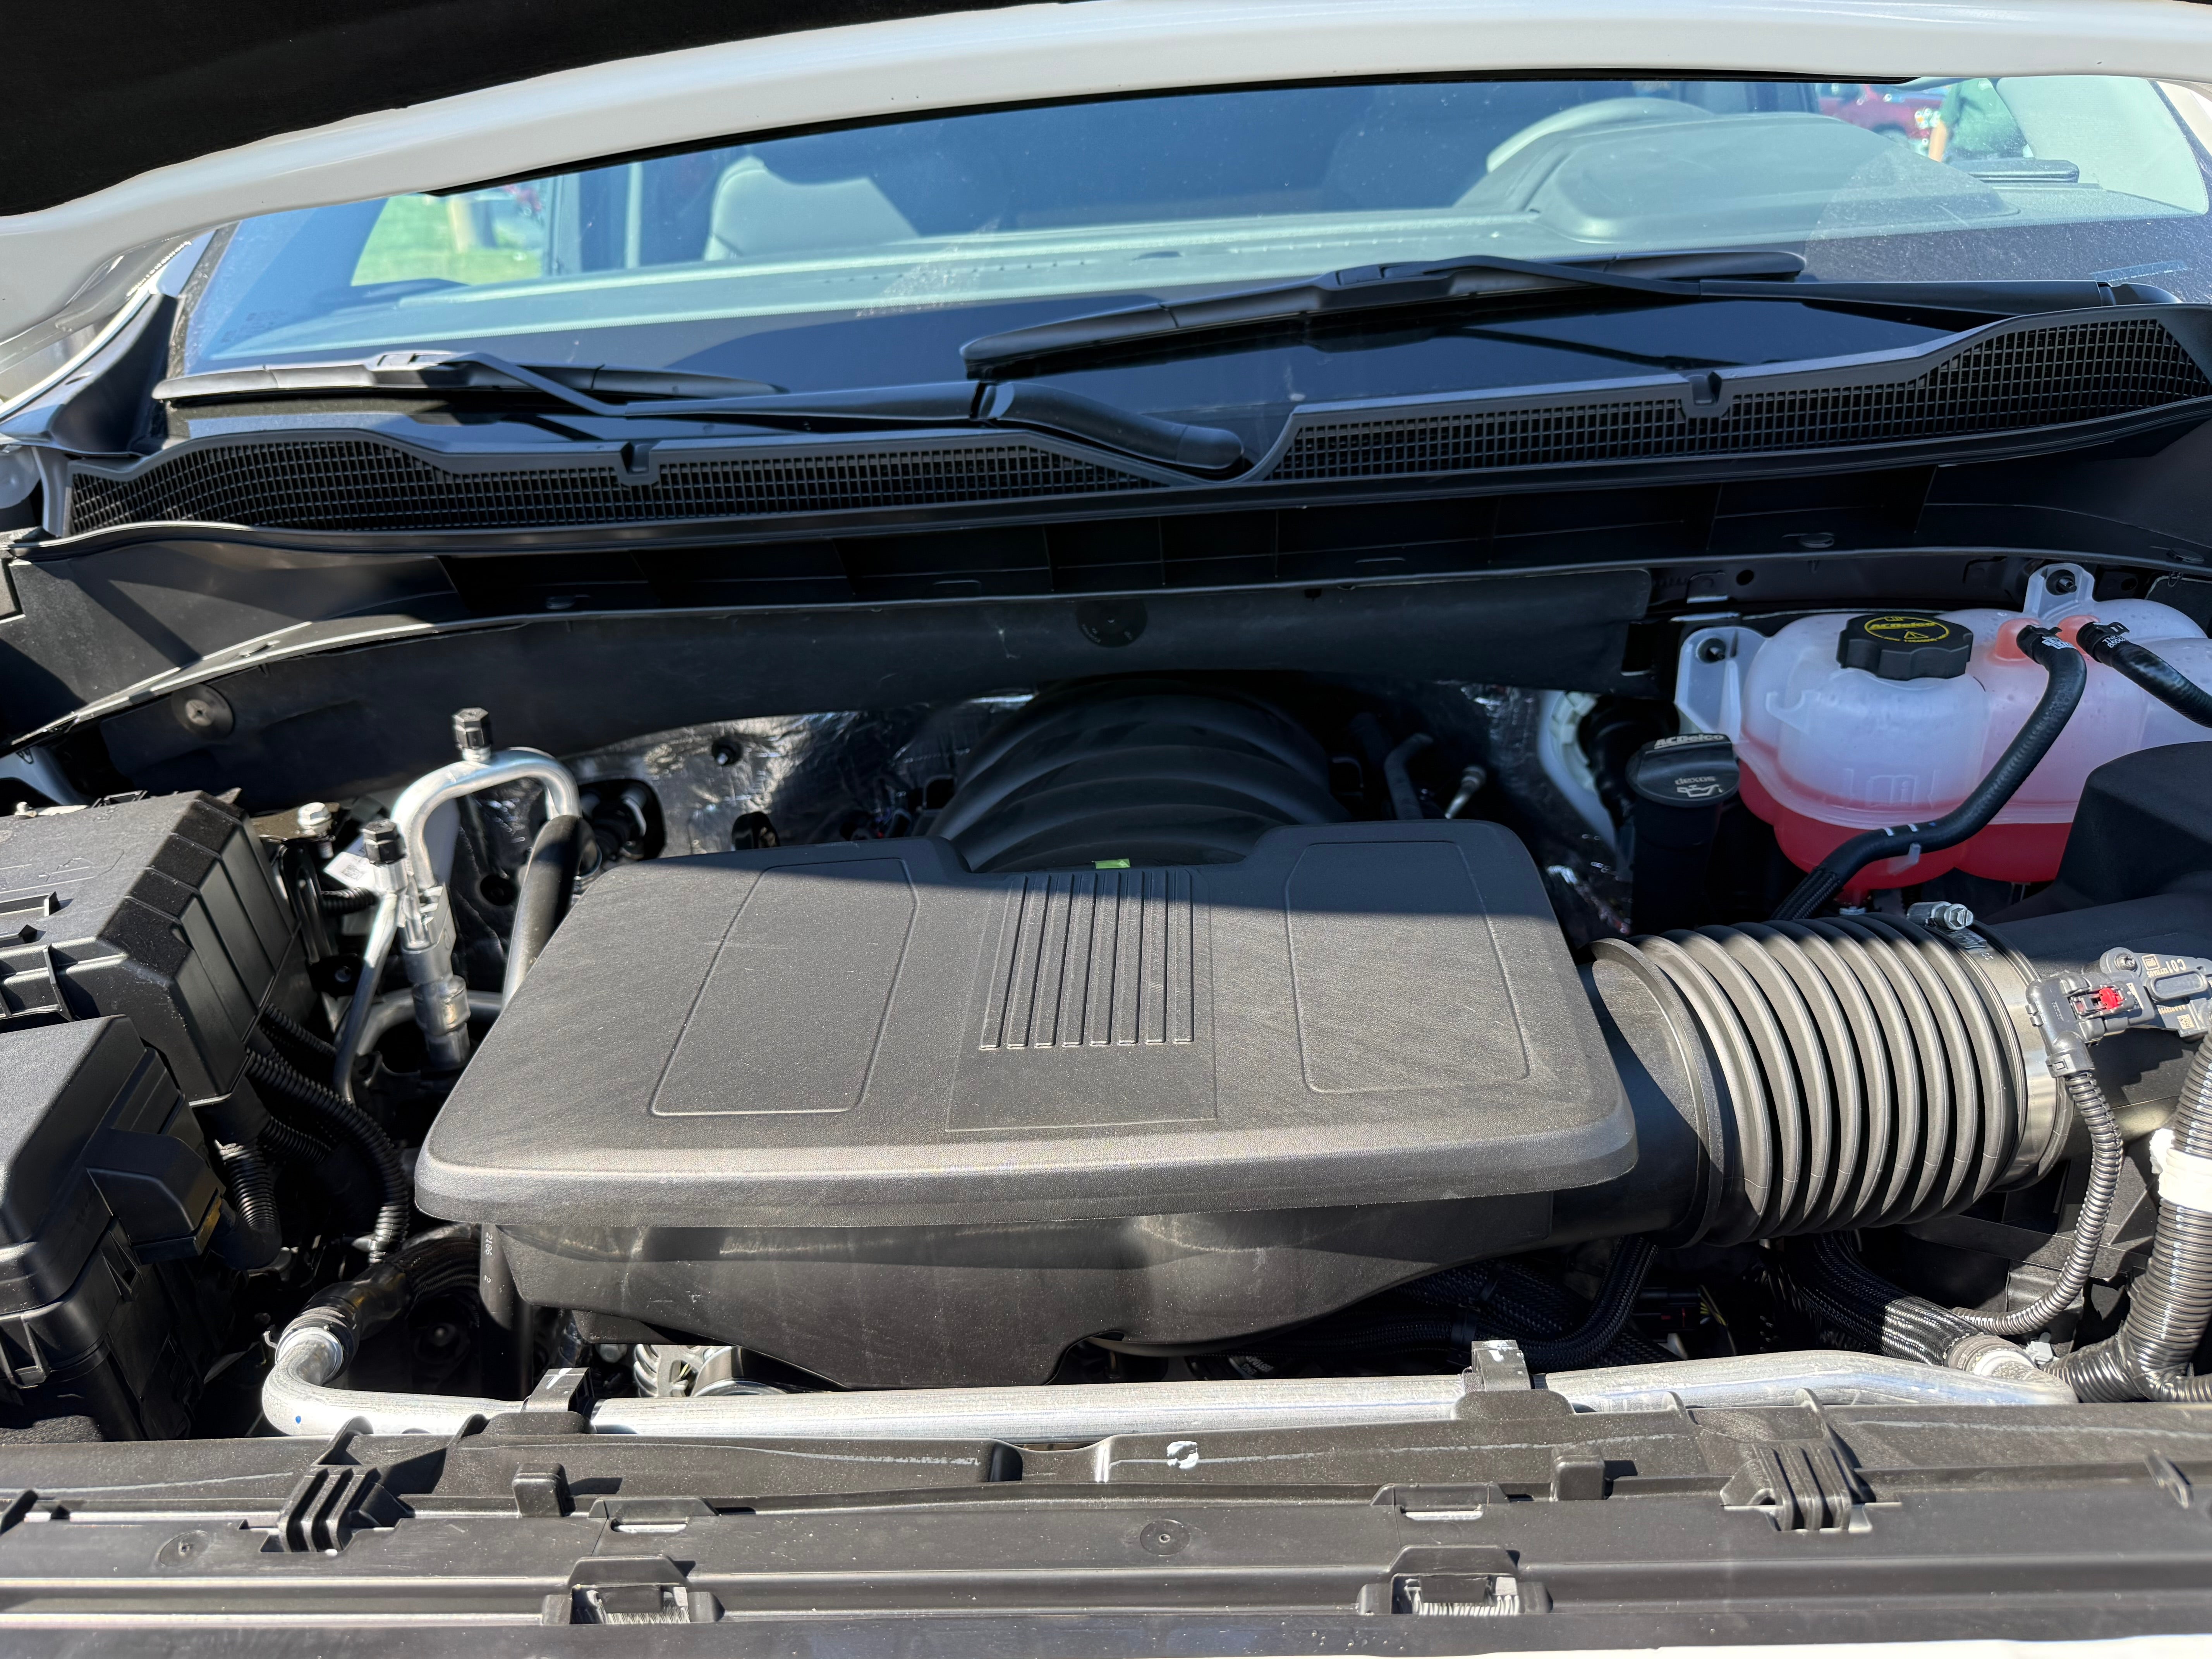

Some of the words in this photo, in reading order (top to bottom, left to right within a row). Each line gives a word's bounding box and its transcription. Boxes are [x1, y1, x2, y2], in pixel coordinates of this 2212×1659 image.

[1654, 734, 1724, 749] ACDelco
[1675, 776, 1716, 785] dexos
[2166, 959, 2186, 973] C01
